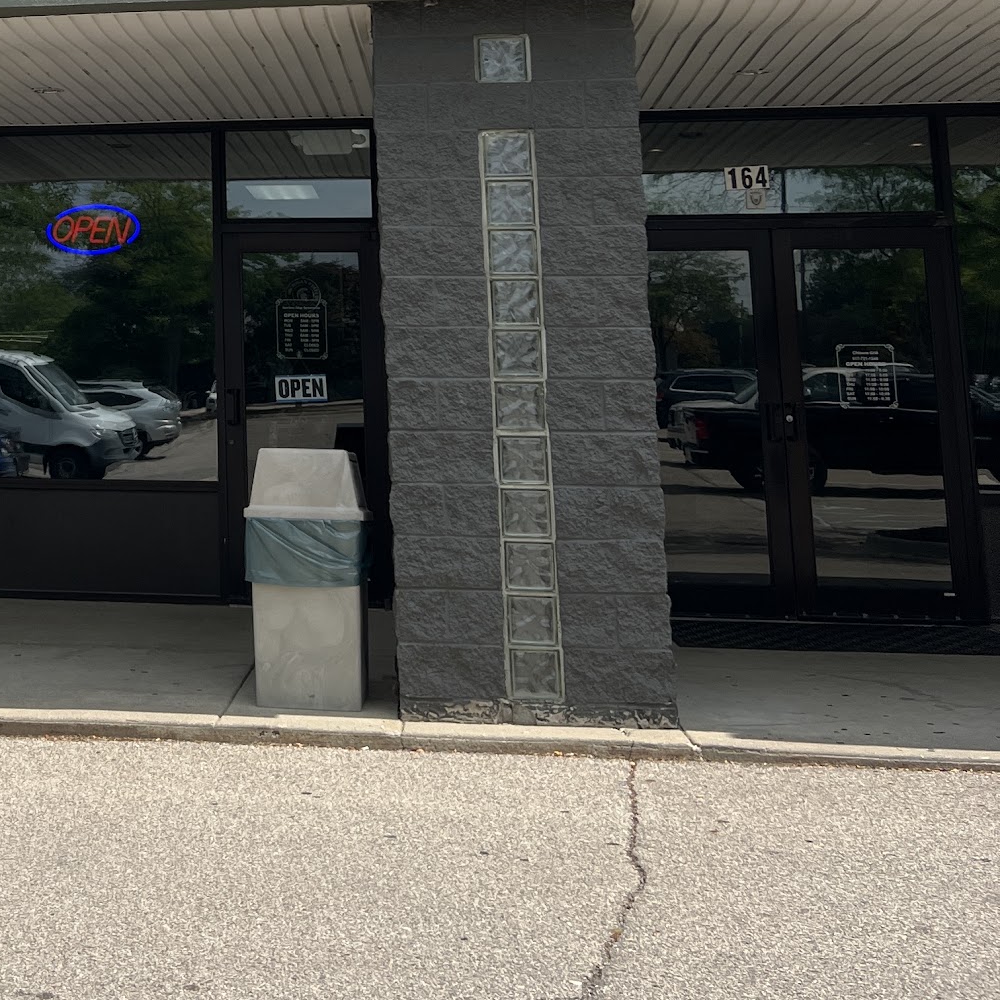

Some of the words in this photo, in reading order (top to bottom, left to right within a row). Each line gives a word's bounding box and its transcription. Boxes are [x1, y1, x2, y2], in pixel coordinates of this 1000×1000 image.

[728, 166, 767, 189] 164
[52, 215, 132, 245] OPEN
[278, 378, 325, 399] OPEN
